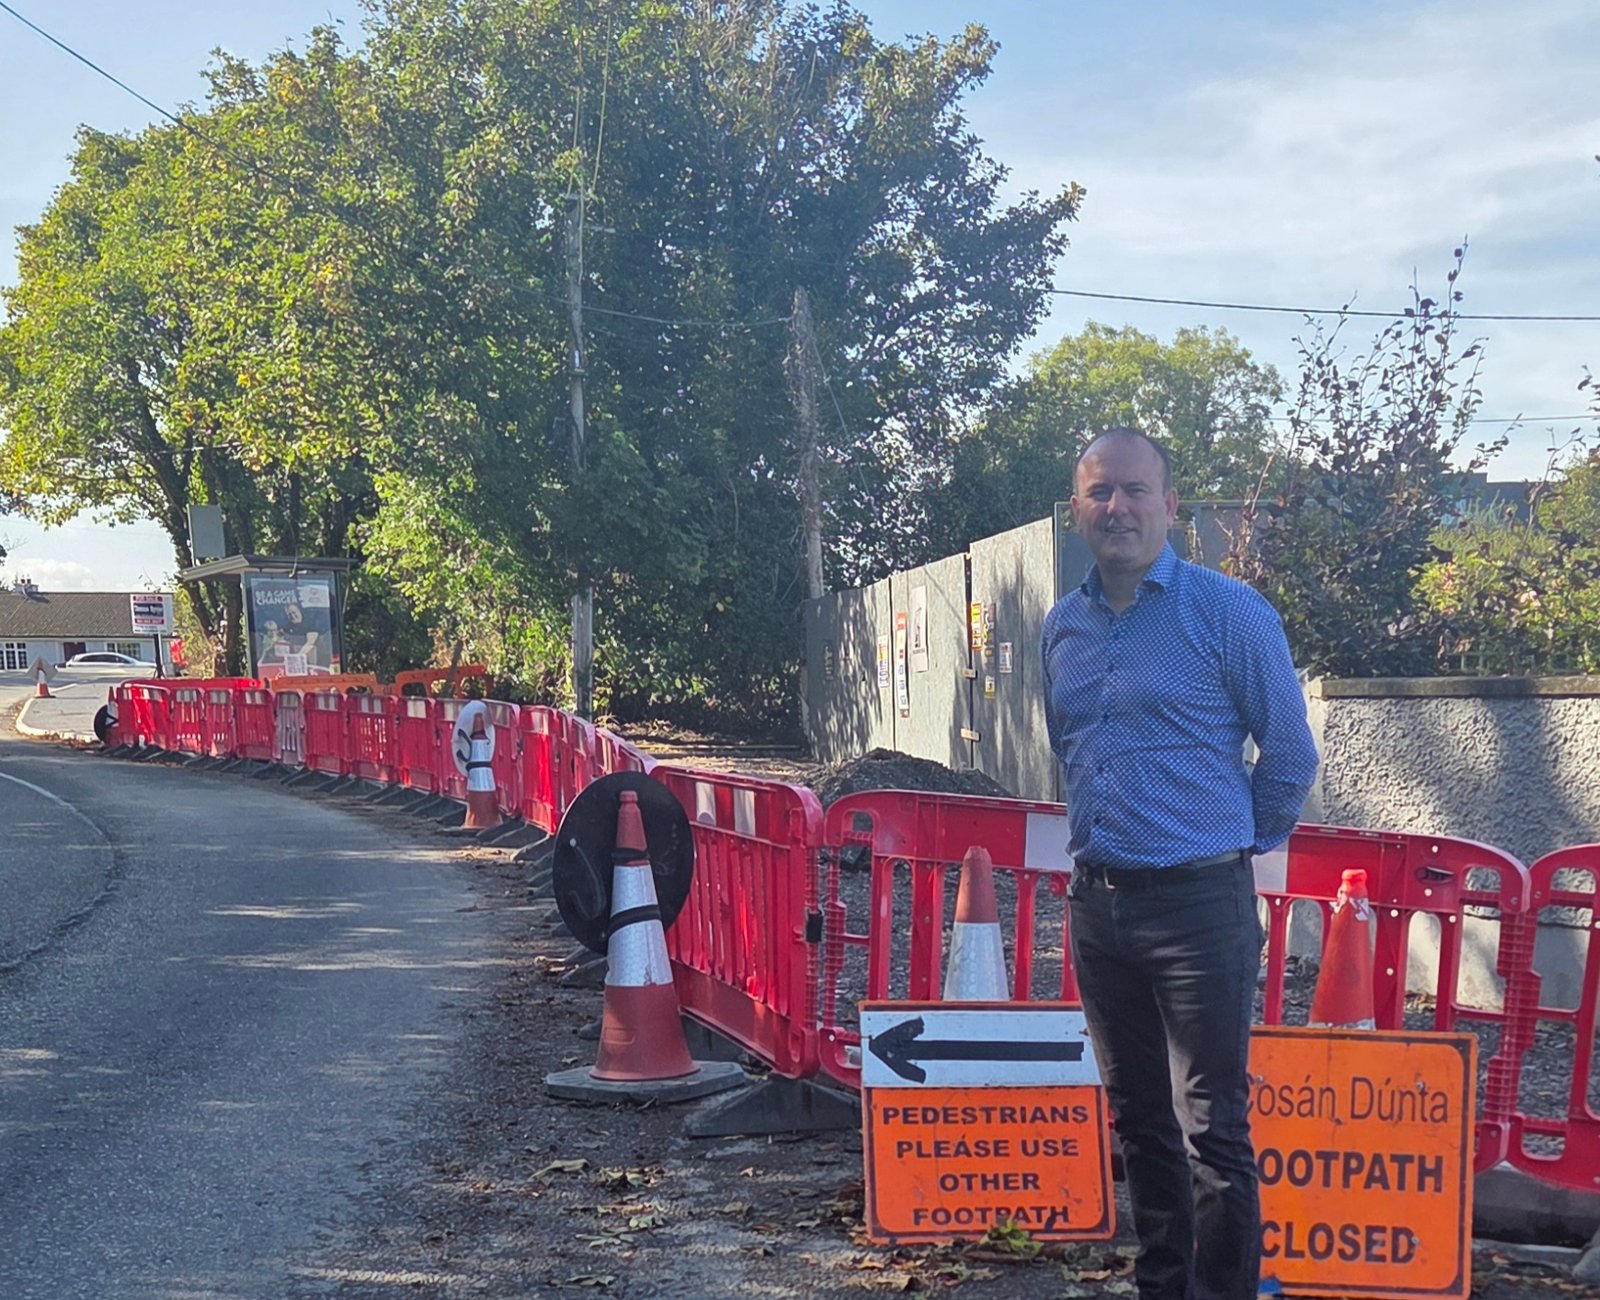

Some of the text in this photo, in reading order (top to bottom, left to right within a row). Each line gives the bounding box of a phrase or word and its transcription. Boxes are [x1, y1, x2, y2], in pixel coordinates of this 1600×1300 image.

[1247, 1072, 1449, 1124] osán Dúnta
[882, 1105, 1088, 1125] PEDESTRIANS
[896, 1138, 1079, 1159] PLEASE USE
[1257, 1147, 1444, 1193] OOTPATH
[939, 1172, 1040, 1192] OTHER
[912, 1205, 1070, 1226] FOOTPATH
[1260, 1219, 1417, 1264] CLOSED
